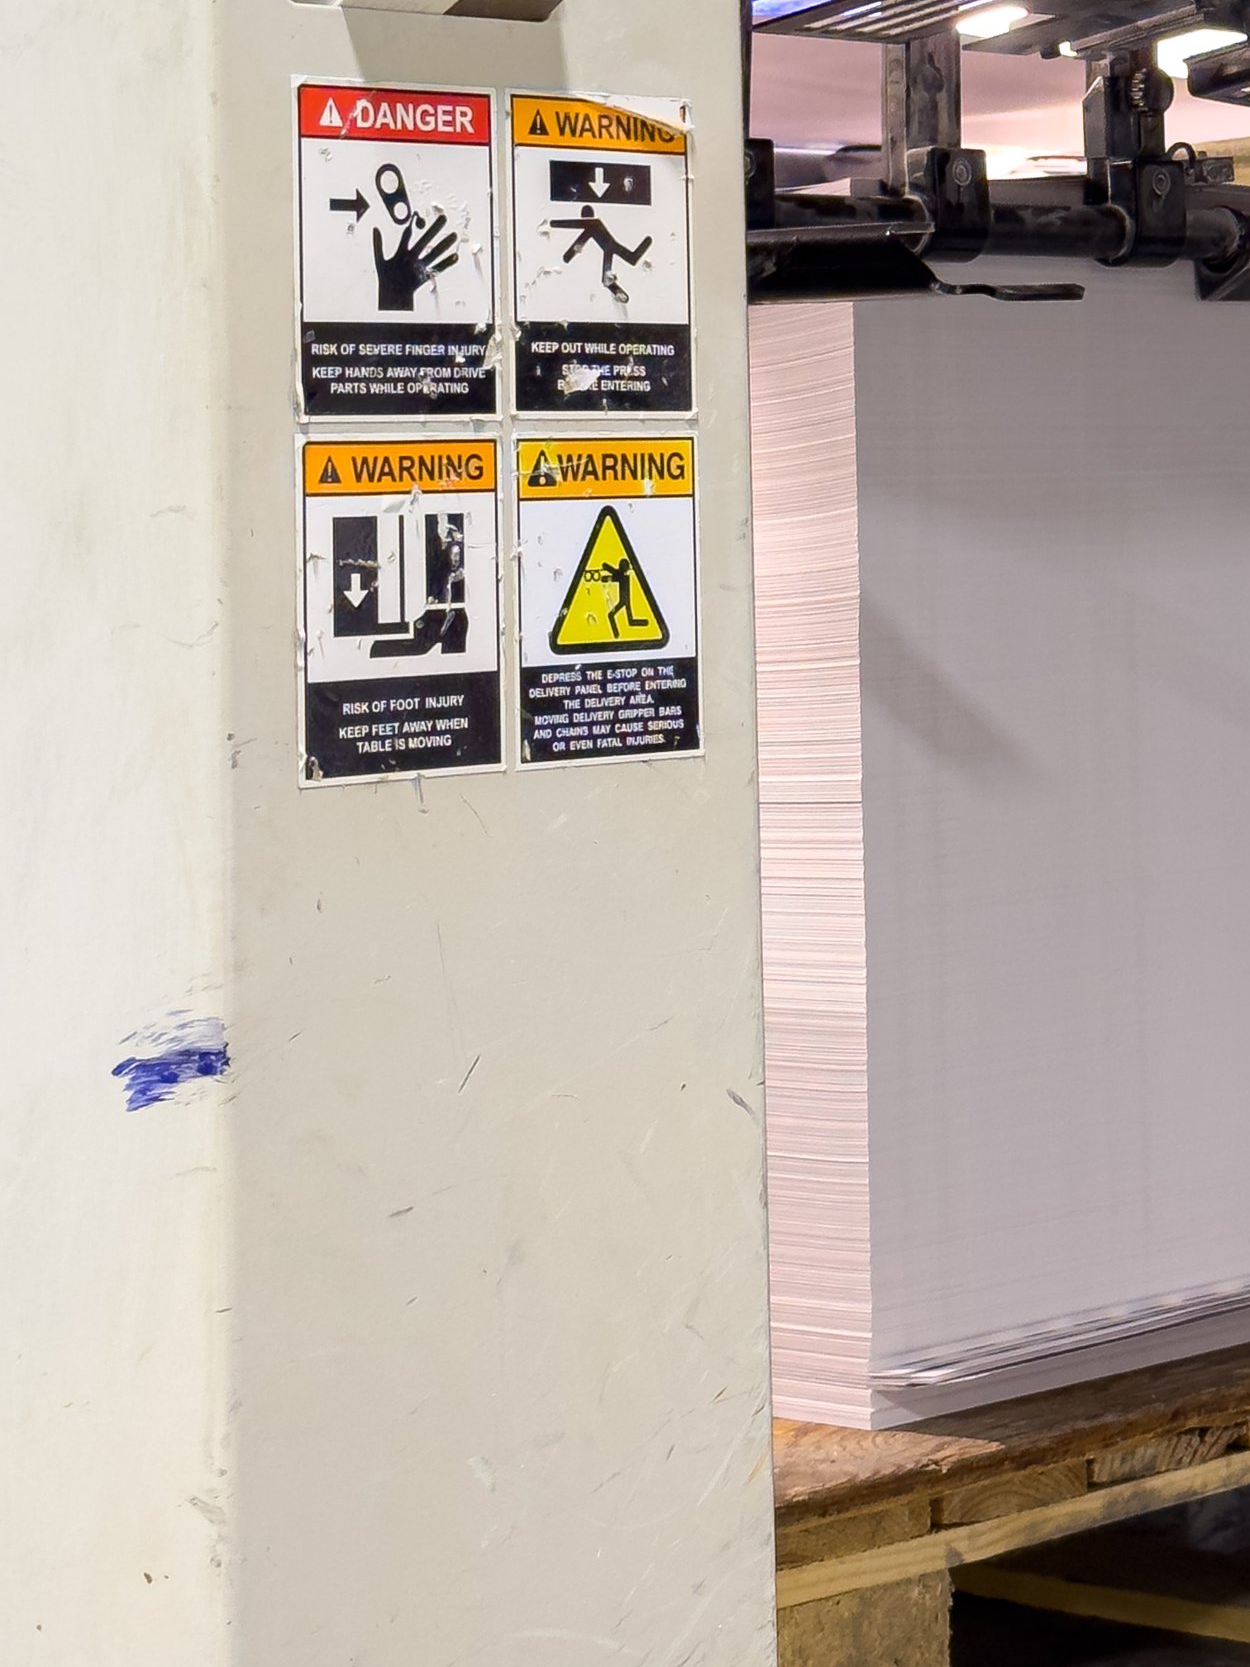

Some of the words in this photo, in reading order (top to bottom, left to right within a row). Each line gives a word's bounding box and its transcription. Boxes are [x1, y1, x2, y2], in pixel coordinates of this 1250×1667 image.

[356, 101, 475, 133] DANGER
[311, 343, 338, 355] RISK
[340, 343, 355, 355] OF
[359, 343, 402, 356] SEVERE
[405, 344, 445, 356] FINGER
[531, 342, 559, 354] KEEP
[561, 342, 582, 354] OUT
[584, 342, 616, 355] WHILE
[619, 343, 675, 356] OPERATING
[312, 367, 342, 379] KEEP
[345, 367, 384, 379] HANDS
[386, 367, 418, 379] AWAY
[453, 367, 486, 379] DRIVE
[330, 382, 367, 394] PARTS
[369, 382, 405, 394] WHILE
[601, 380, 651, 392] ENTERING
[351, 453, 484, 482] WARNING
[557, 451, 686, 482] WARNING
[541, 671, 582, 684] DEPRESS
[586, 670, 602, 681] THE
[607, 668, 637, 680] E-STOP
[641, 666, 654, 677] ON
[657, 665, 674, 677] THE
[529, 687, 571, 699] DELIVERY
[575, 684, 602, 695] PANEL
[607, 682, 641, 694] BEFORE
[645, 679, 687, 691] ENTERING
[342, 701, 369, 715] RISK
[372, 700, 387, 714] OF
[390, 697, 420, 712] FOOT
[425, 694, 464, 710] INJURY
[563, 699, 581, 710] THE
[585, 696, 626, 708] DELIVERY
[534, 714, 569, 726] MOVING
[573, 711, 614, 723] DELIVERY
[618, 708, 655, 720] GRIPPER
[659, 706, 682, 717] BARS
[339, 724, 369, 739] KEEP
[372, 722, 399, 738] FEET
[402, 720, 434, 736] AWAY
[436, 717, 469, 733] WHEN
[533, 729, 552, 740] AND
[556, 726, 589, 739] CHAINS
[593, 724, 611, 735] MAY
[615, 722, 644, 734] CAUSE
[648, 719, 684, 731] SERIOUS
[356, 739, 391, 754] TABLE
[394, 738, 405, 752] IS
[407, 734, 452, 750] MOVING
[552, 741, 566, 752] OR
[570, 739, 593, 751] EVEN
[597, 737, 622, 749] FATAL
